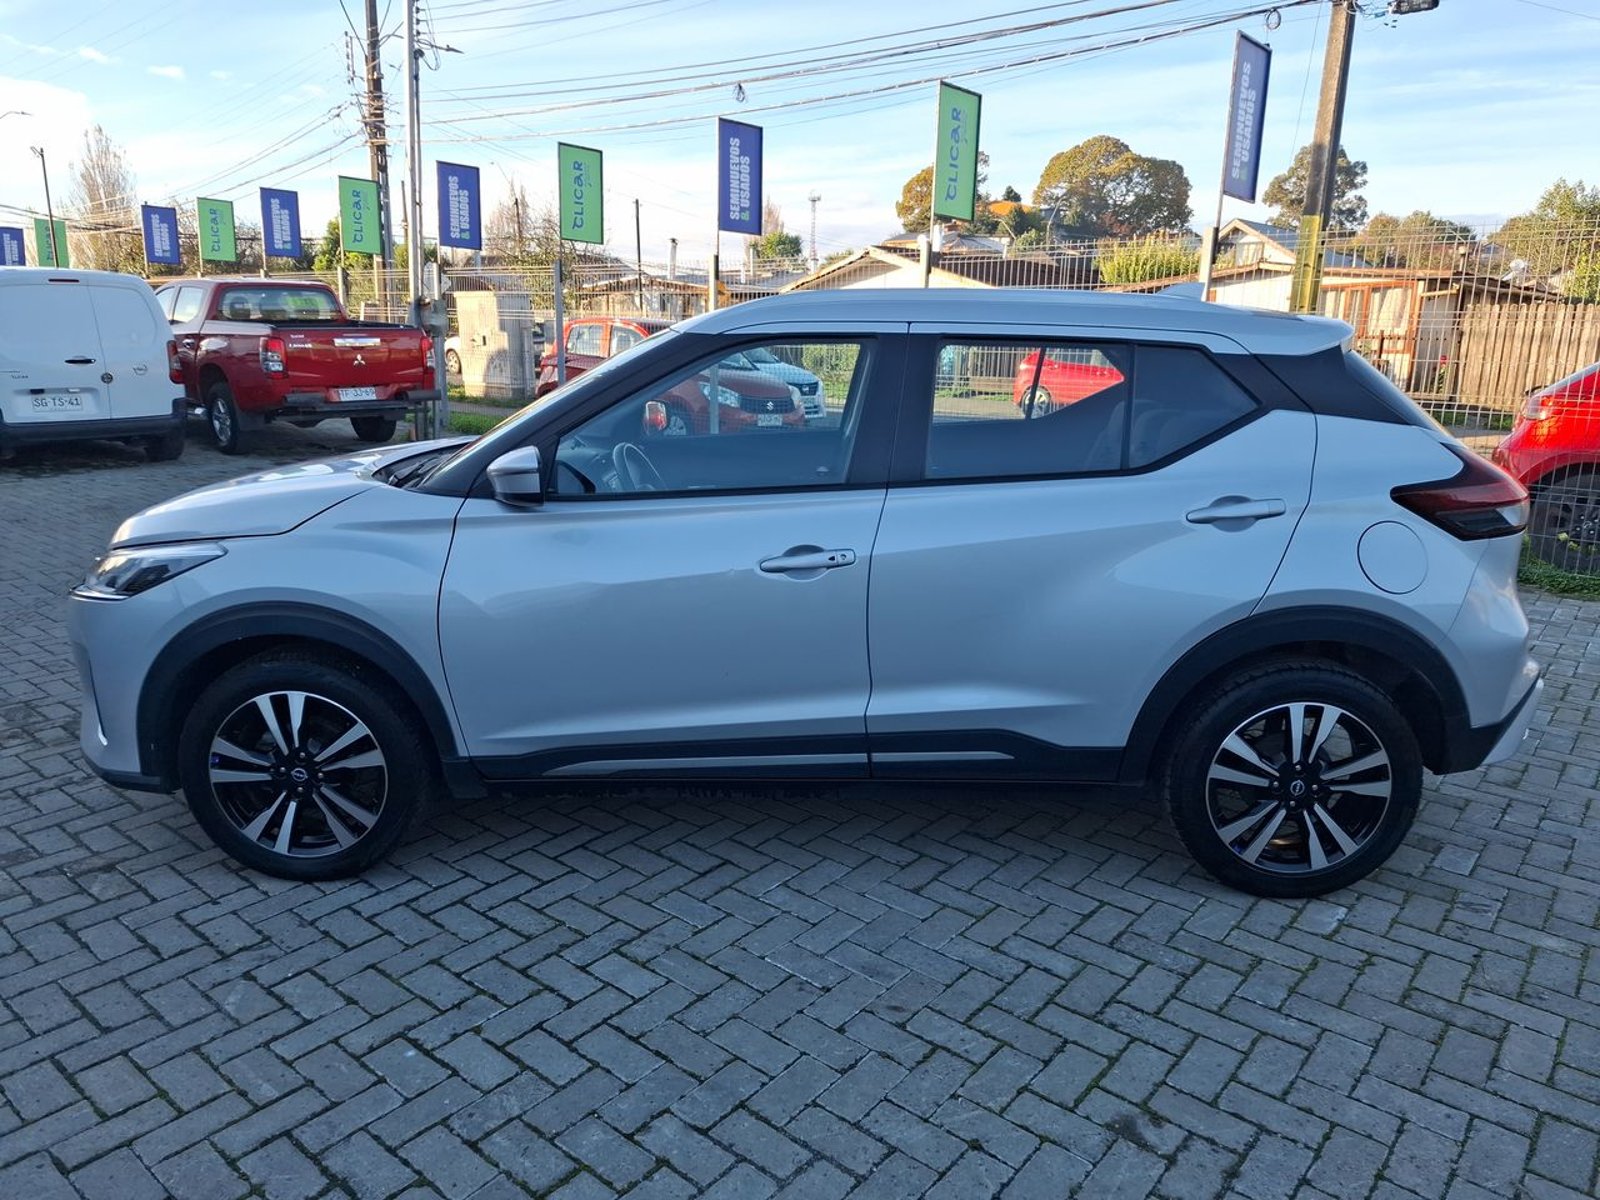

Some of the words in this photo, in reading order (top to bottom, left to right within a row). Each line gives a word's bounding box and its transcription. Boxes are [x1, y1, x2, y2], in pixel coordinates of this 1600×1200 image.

[1231, 61, 1252, 180] SEMINUEVOS
[1241, 88, 1257, 162] USADOS
[448, 175, 460, 239] SEMINUEVOS
[459, 189, 470, 230] USADOS
[729, 137, 741, 221] SEMINUEVOS
[740, 155, 751, 208] USADOS
